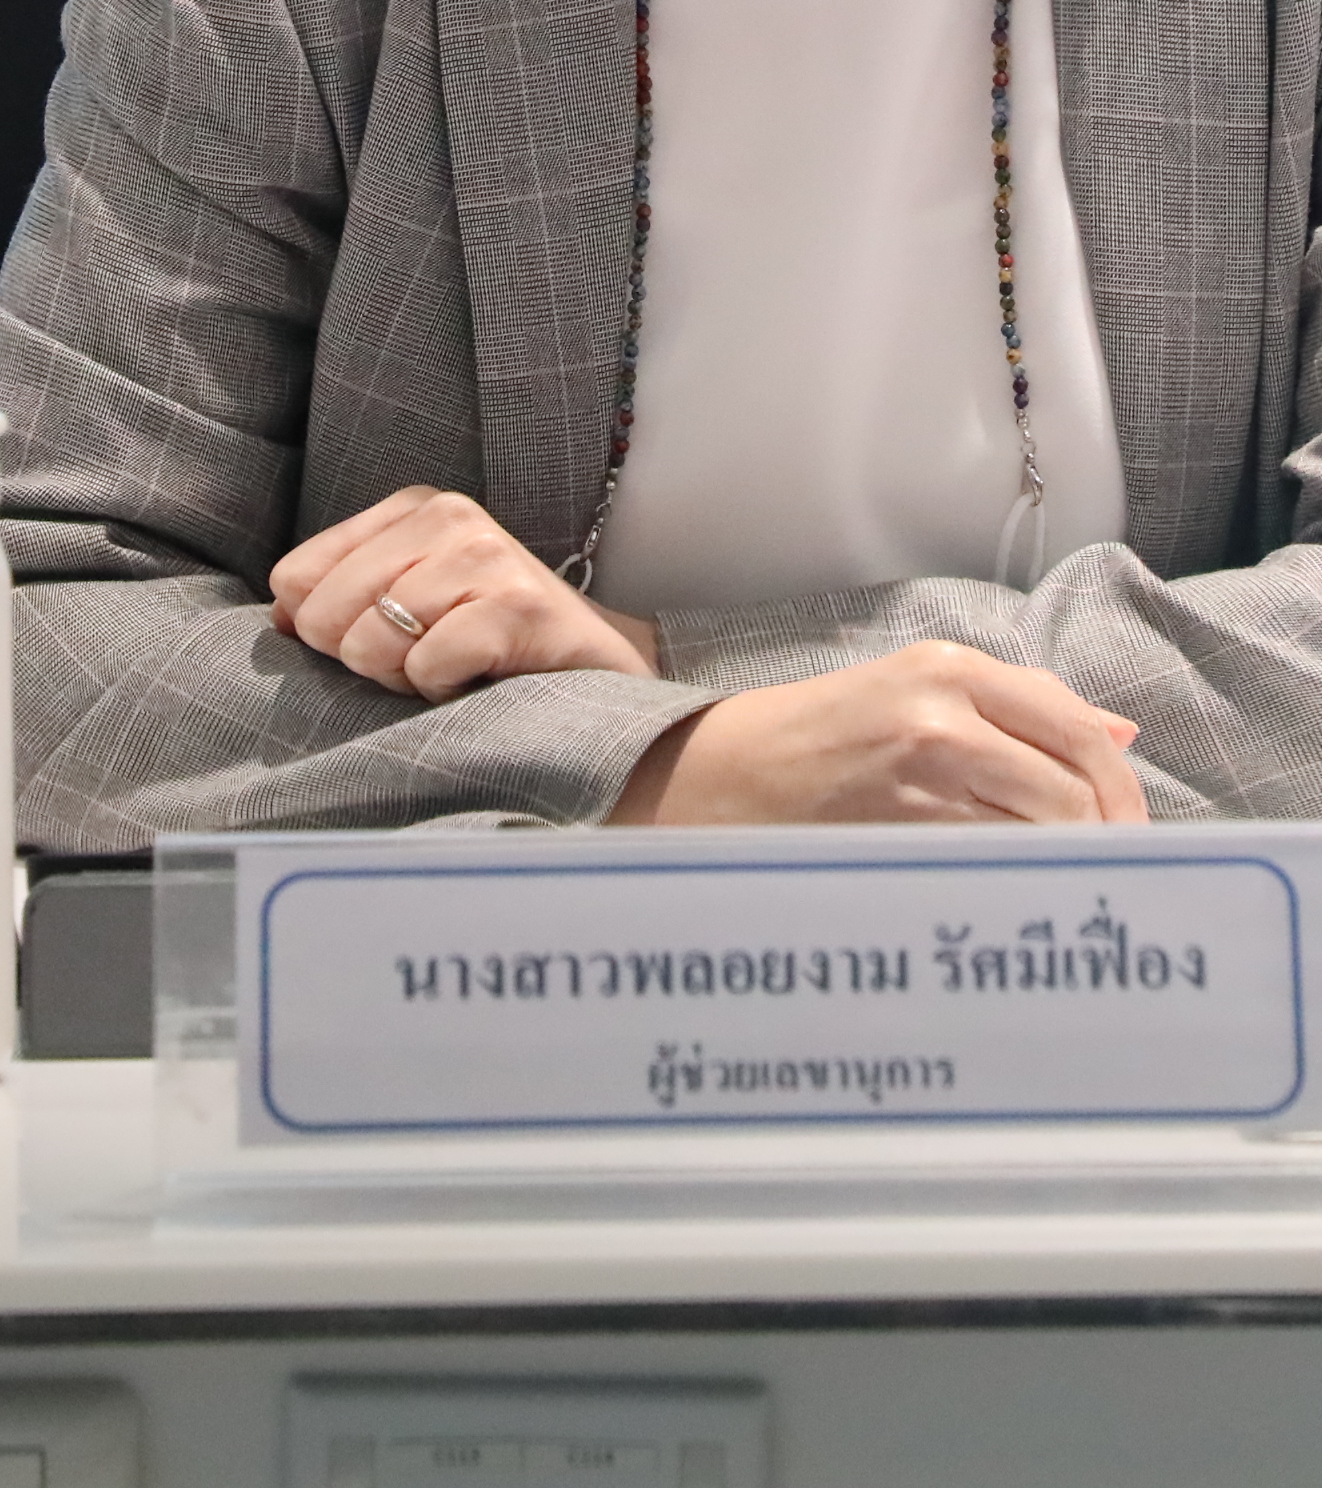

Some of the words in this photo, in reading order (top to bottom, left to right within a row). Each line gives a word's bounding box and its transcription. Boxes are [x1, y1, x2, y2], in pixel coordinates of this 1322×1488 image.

[394, 947, 912, 1001] นางสาวพลอยงาม
[933, 894, 1207, 992] รัศมีเฟื่อง
